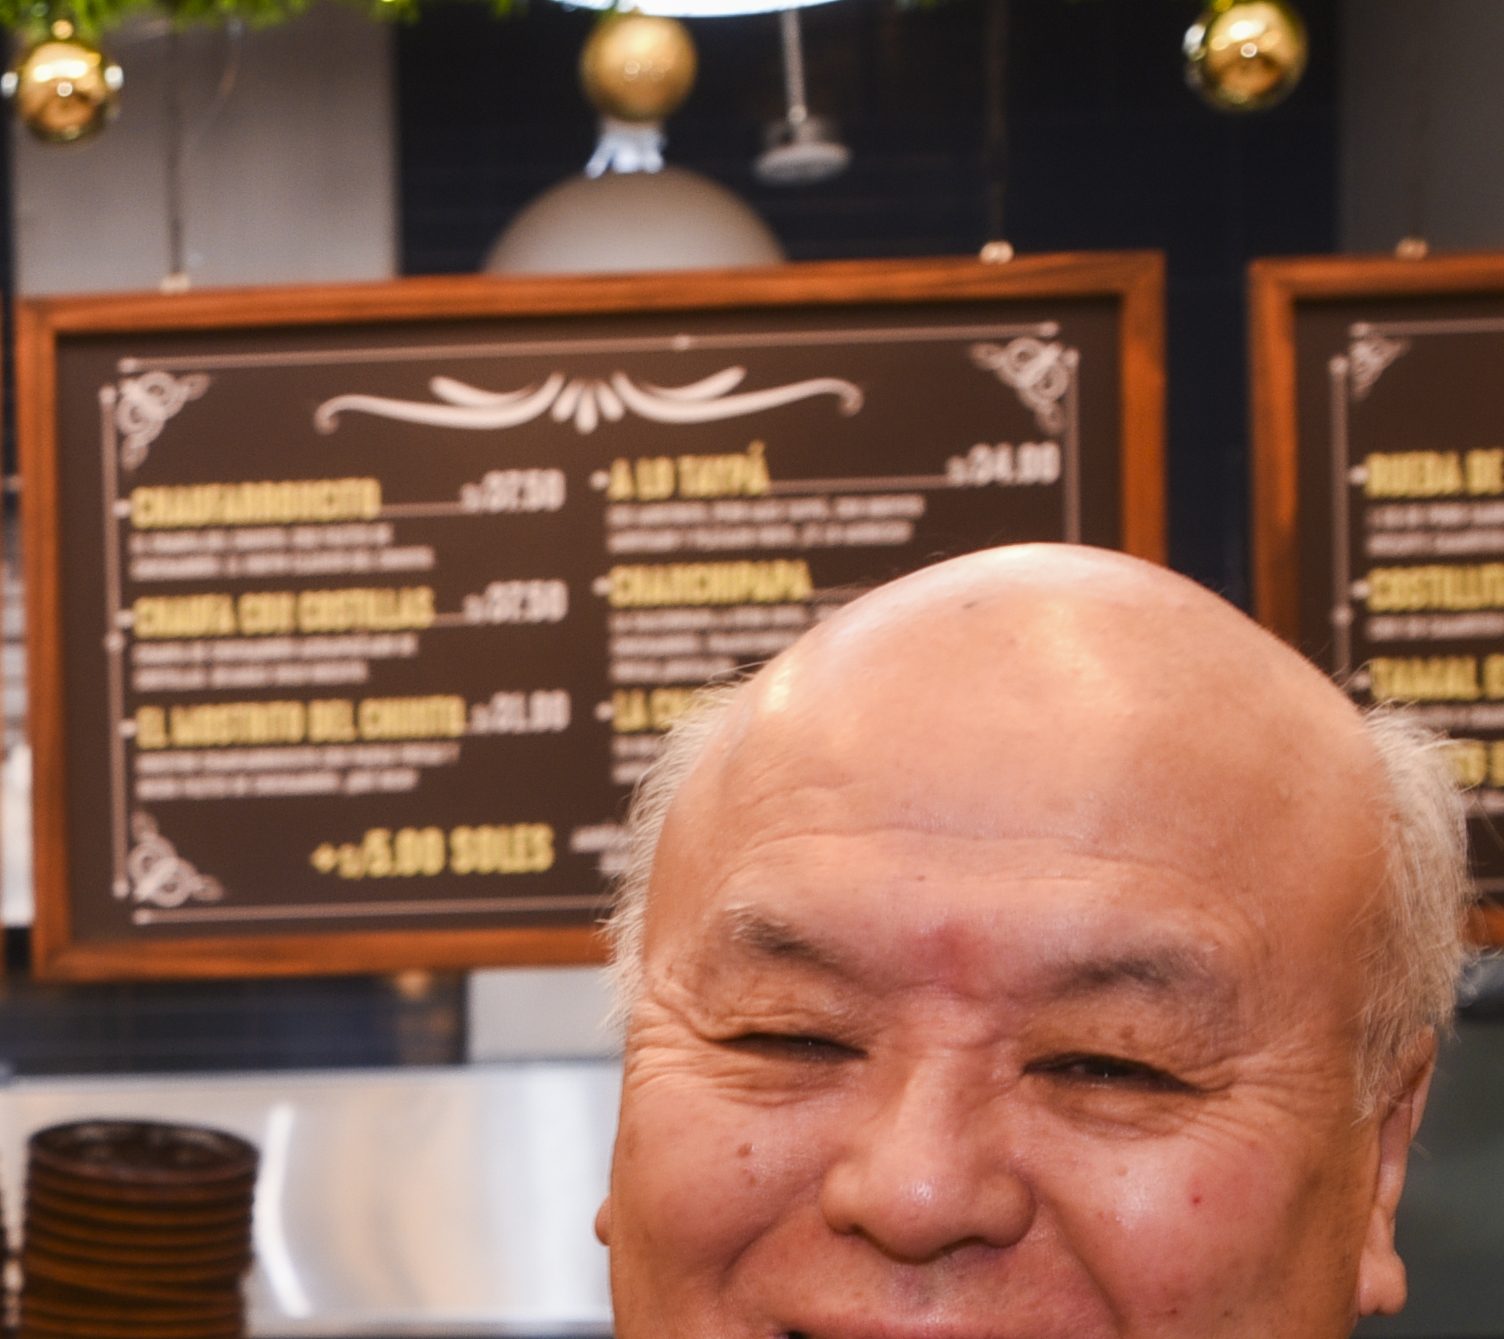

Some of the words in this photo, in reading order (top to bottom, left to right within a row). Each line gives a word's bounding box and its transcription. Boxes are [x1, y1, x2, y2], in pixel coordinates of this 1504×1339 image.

[608, 458, 633, 499] A
[636, 458, 674, 499] LO
[450, 825, 553, 873] SOLES
